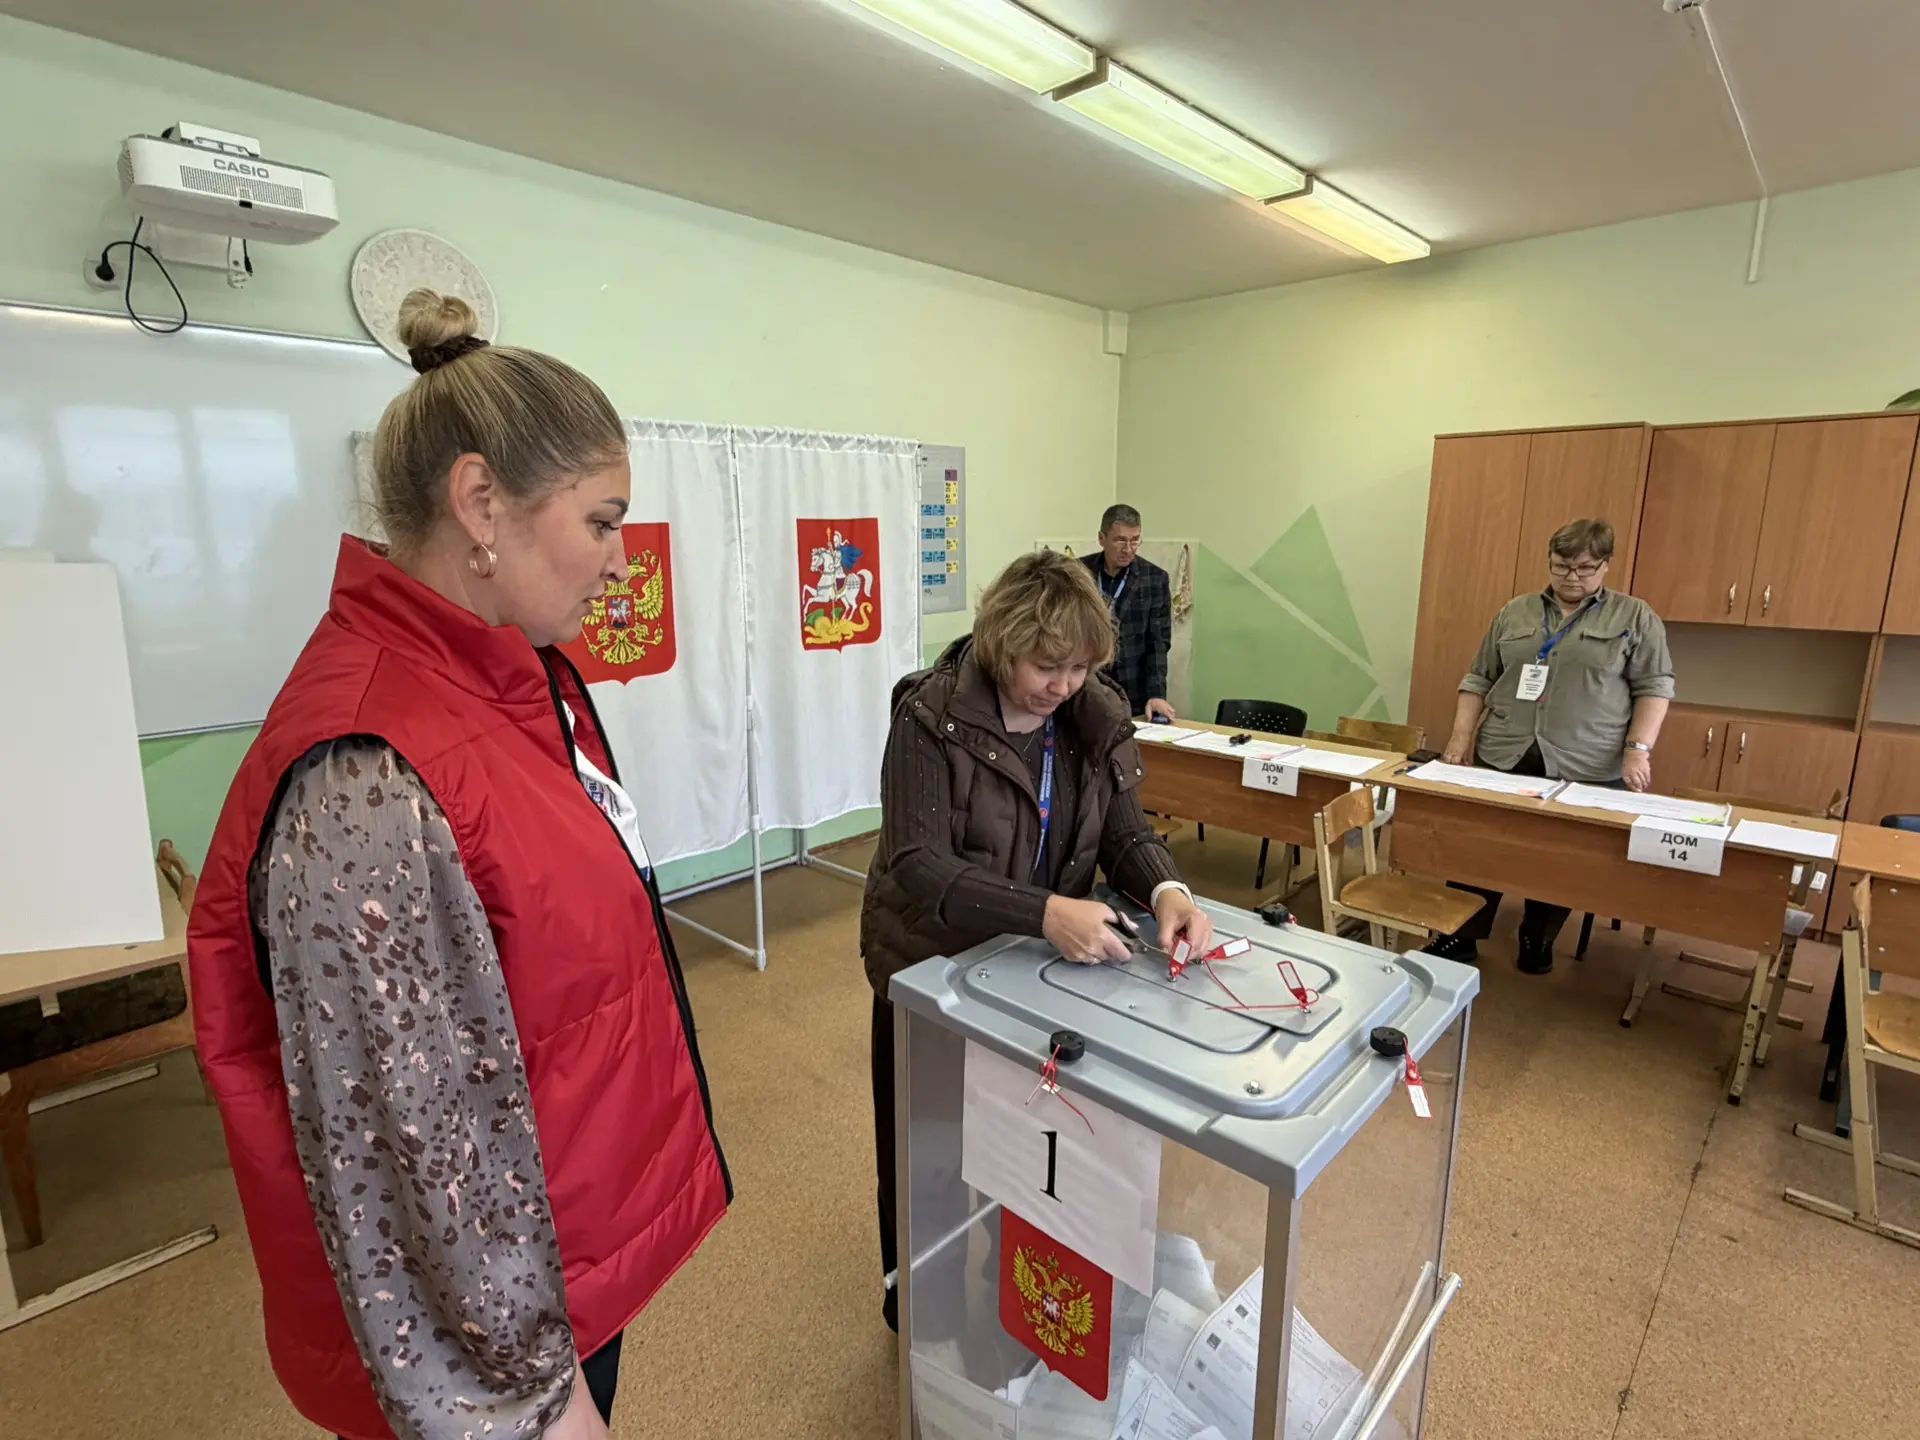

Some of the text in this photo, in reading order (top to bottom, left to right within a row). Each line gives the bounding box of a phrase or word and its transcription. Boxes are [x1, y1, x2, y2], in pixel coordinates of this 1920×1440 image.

[213, 158, 270, 179] CASIO
[1261, 762, 1284, 774] ДОМ
[1266, 775, 1279, 786] 12
[1660, 832, 1698, 848] ДОМ
[1668, 848, 1688, 861] 14
[1039, 1130, 1062, 1203] 1
